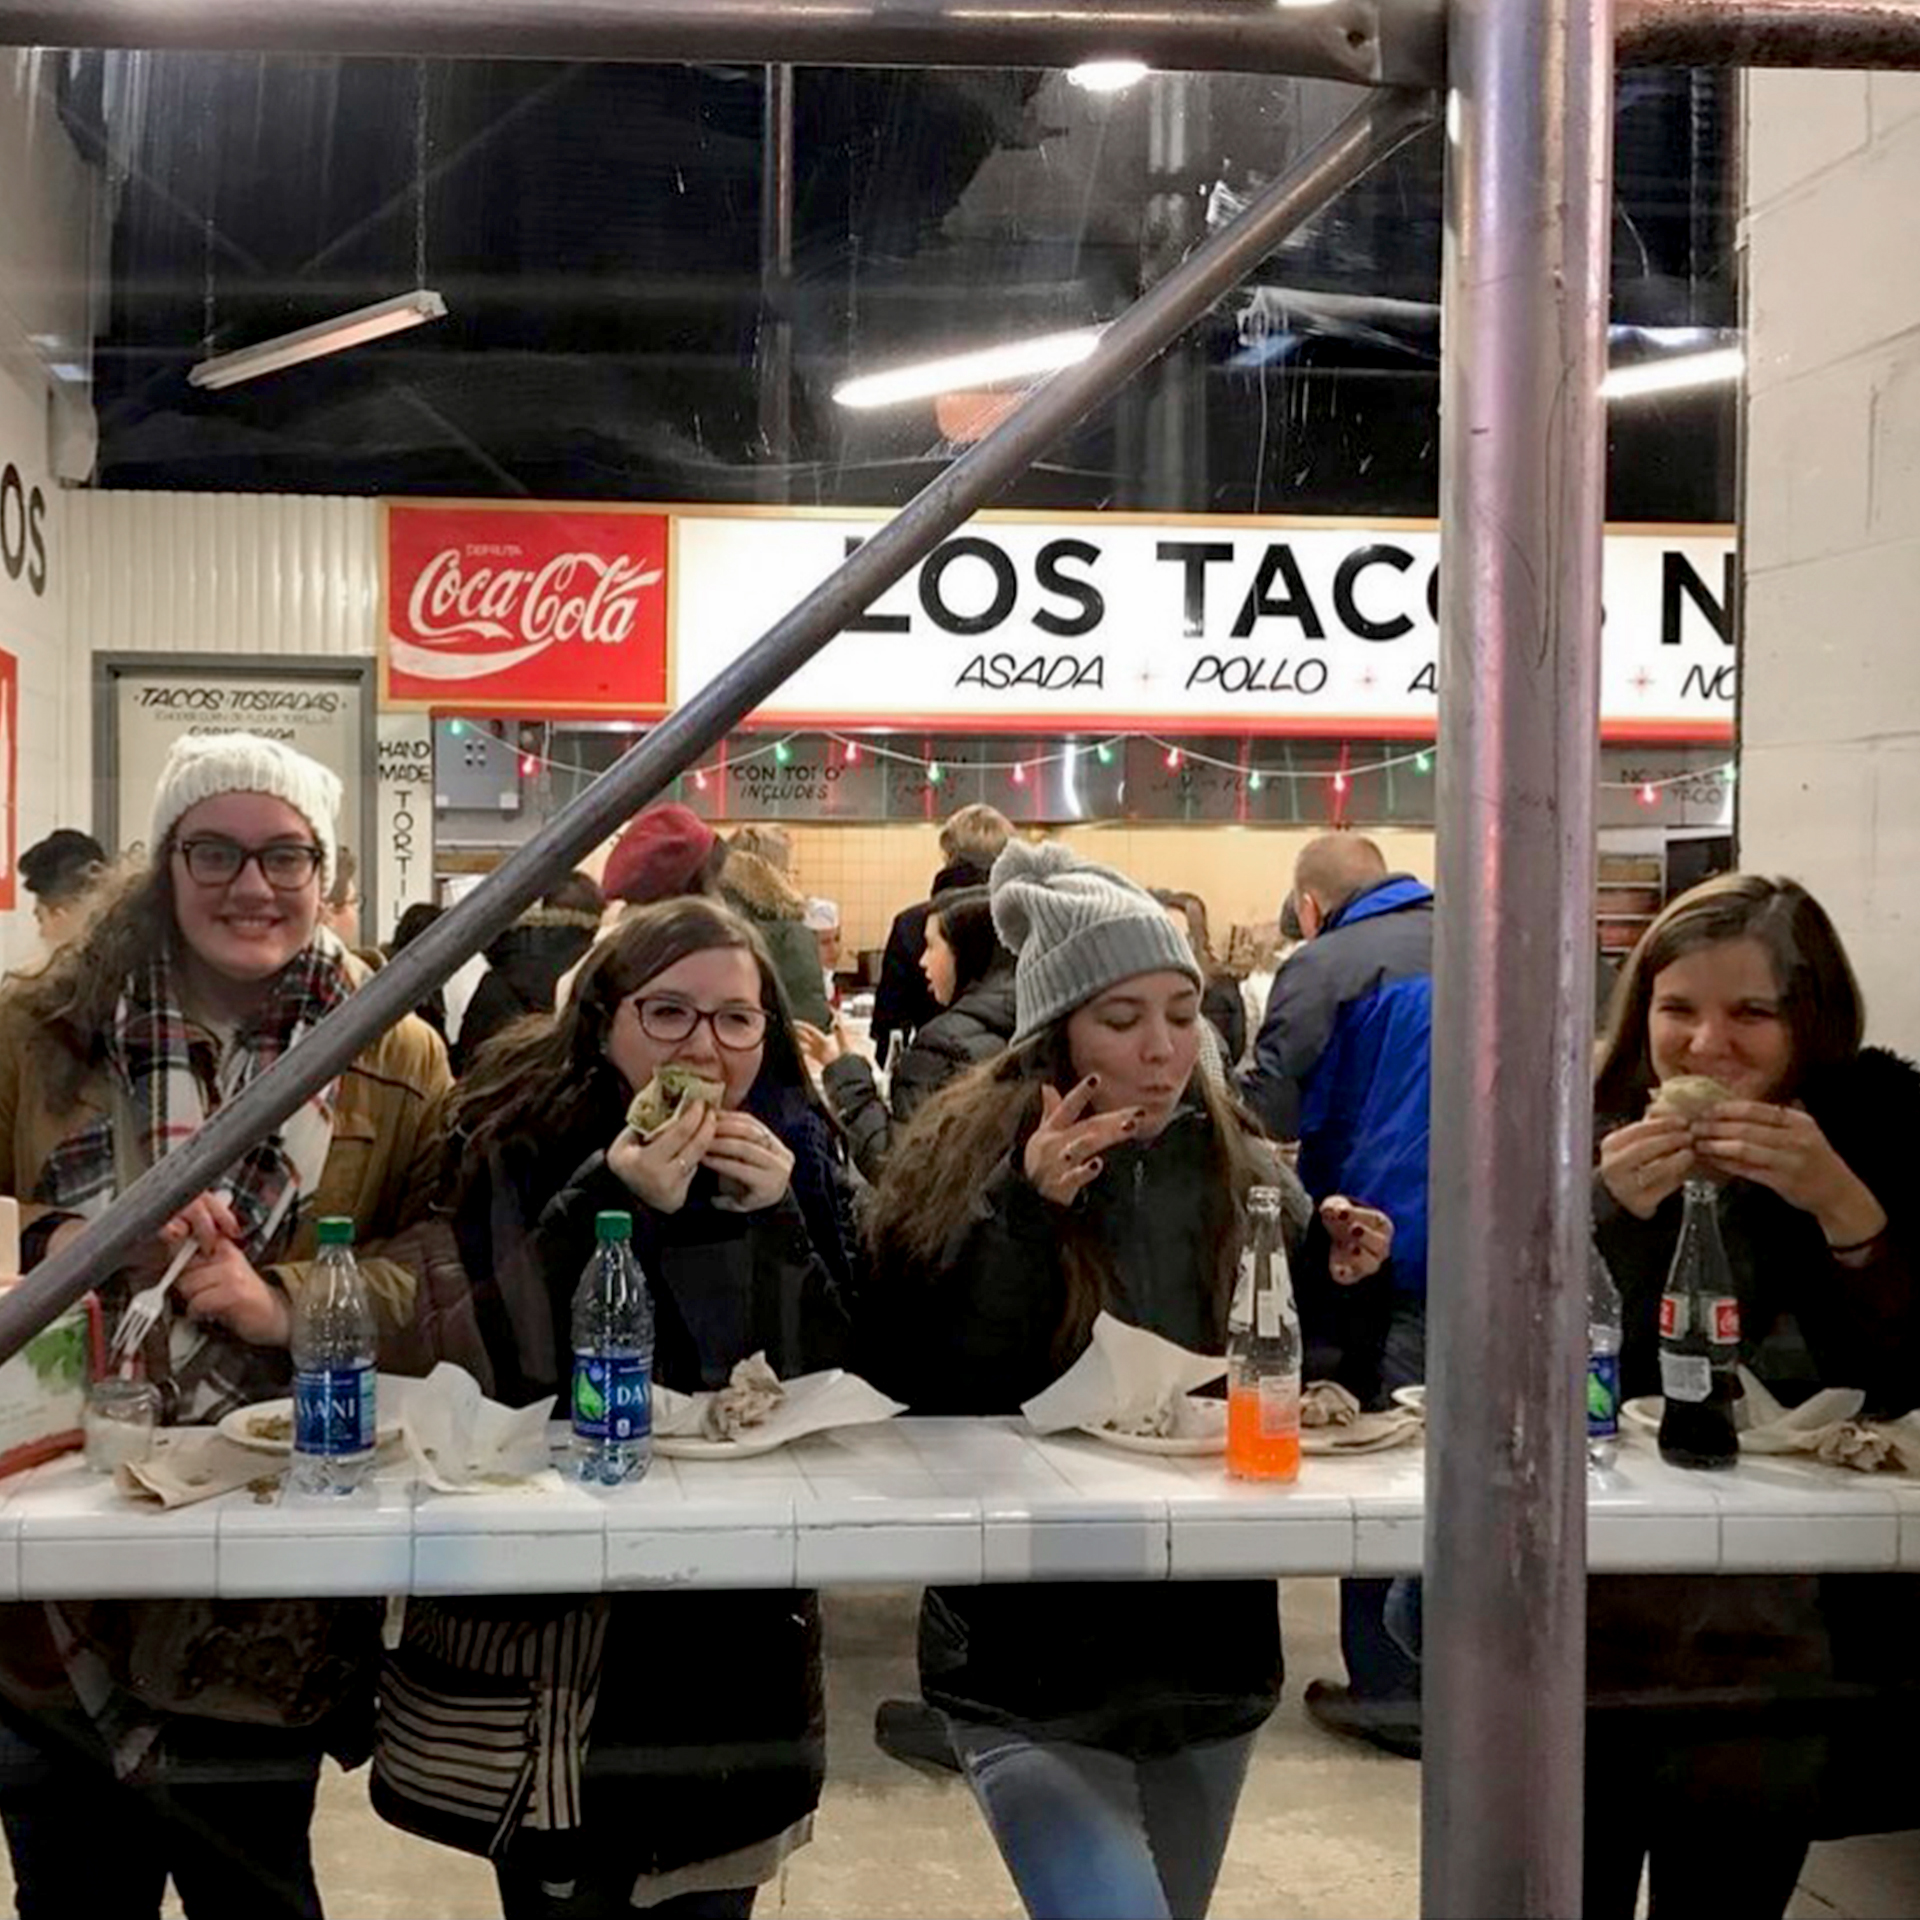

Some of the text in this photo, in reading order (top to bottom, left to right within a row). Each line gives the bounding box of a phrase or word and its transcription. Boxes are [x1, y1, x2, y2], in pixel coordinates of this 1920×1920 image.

[1, 462, 46, 597] OS
[844, 536, 1735, 645] LOS TAC N
[956, 653, 1103, 690] ASADA
[1185, 655, 1328, 694] POLLO
[140, 688, 340, 713] TACOS TOSTADAS
[379, 740, 431, 759] HAND
[379, 764, 431, 783] MADE
[740, 783, 829, 803] INCLUDES
